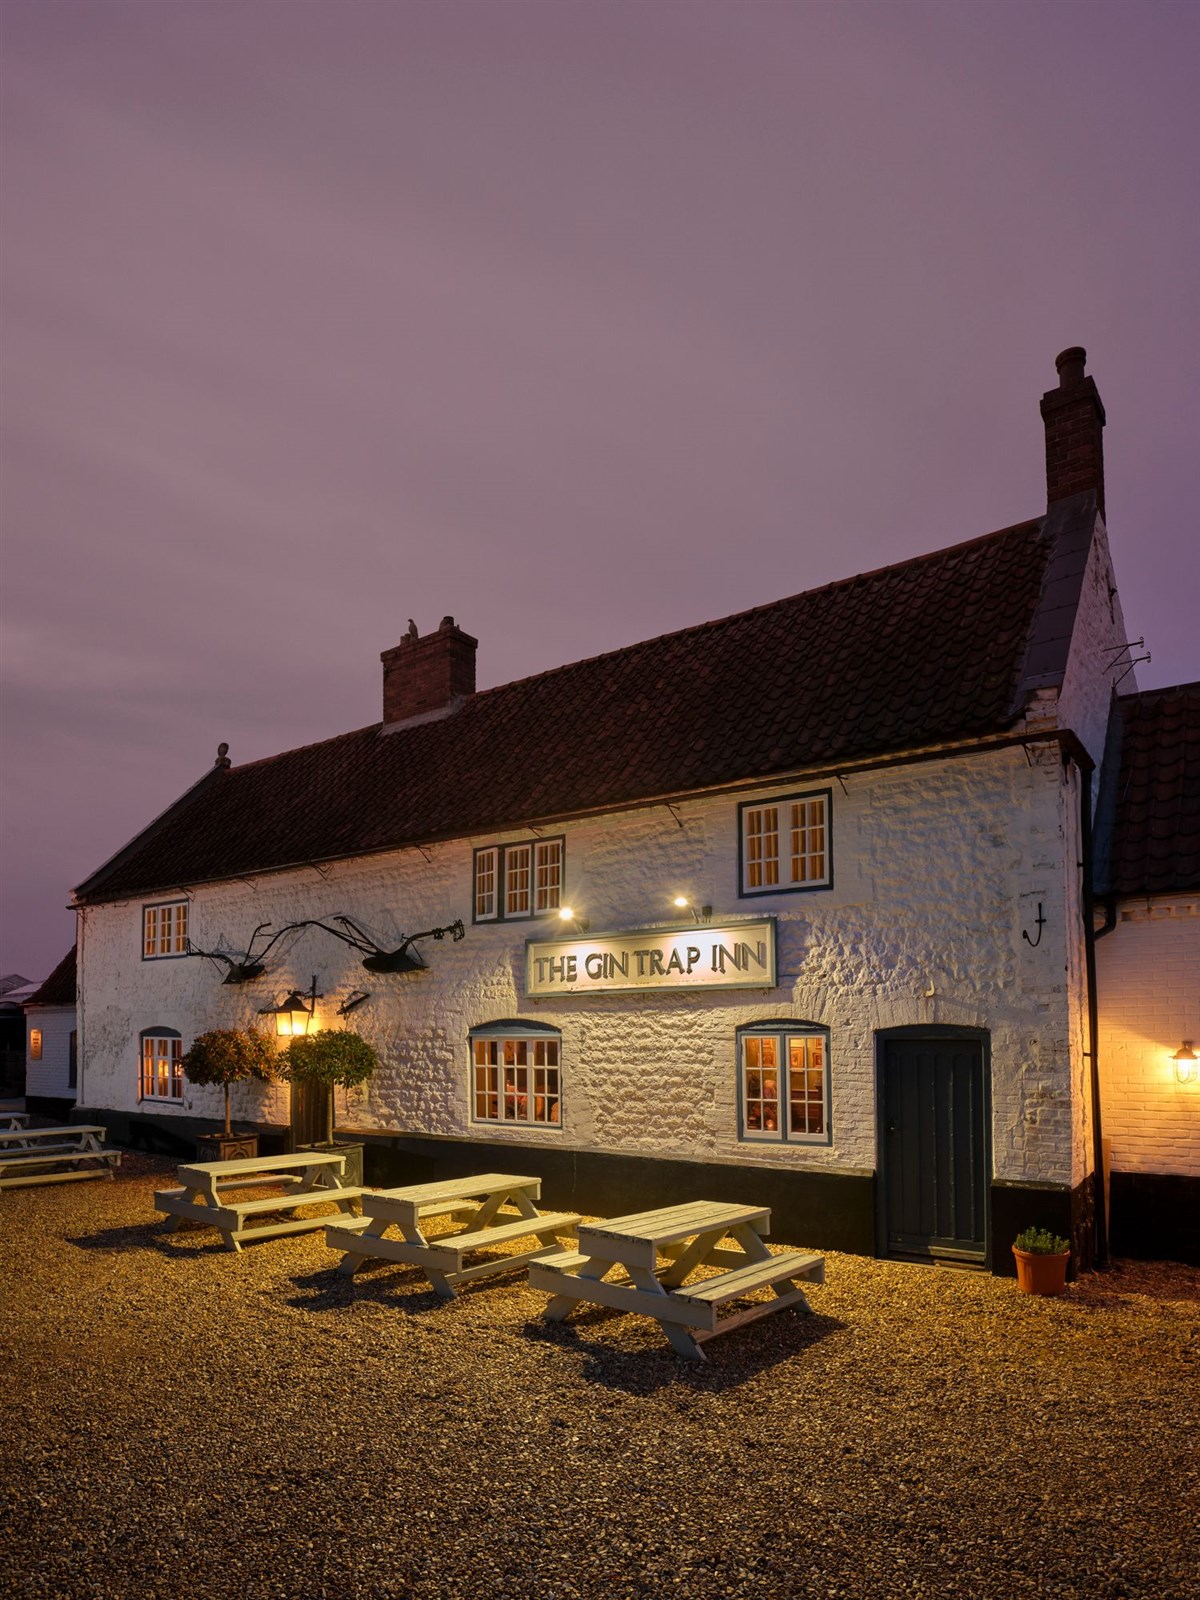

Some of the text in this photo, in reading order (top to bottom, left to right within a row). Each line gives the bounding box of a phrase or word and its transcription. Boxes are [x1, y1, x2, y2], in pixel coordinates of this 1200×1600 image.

[534, 940, 767, 983] THE GIN TRAP INN
